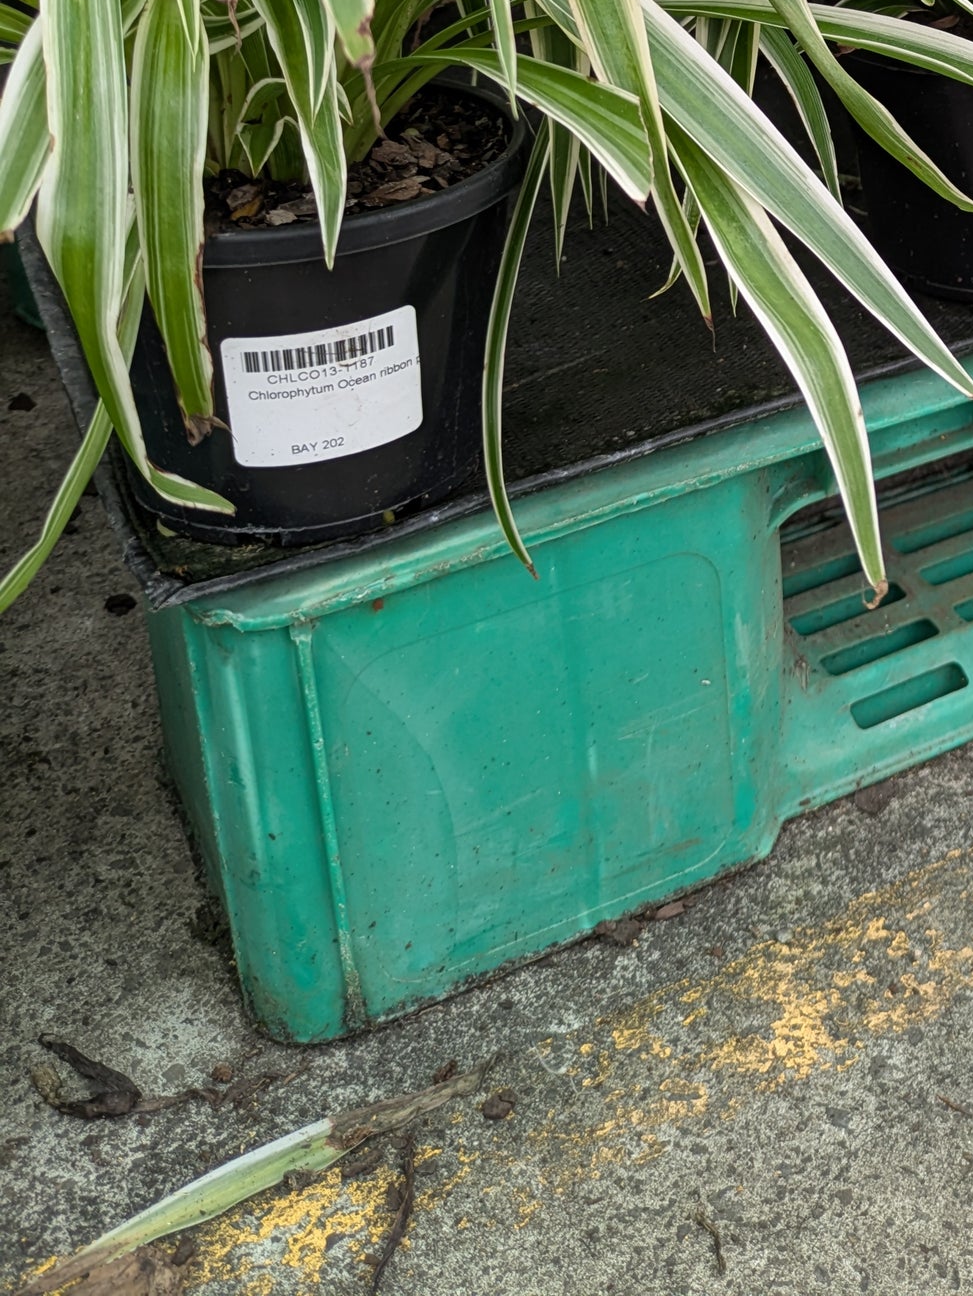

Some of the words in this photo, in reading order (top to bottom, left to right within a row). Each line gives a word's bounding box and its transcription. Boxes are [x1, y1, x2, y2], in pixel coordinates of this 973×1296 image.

[248, 383, 335, 401] Chlorophytum
[337, 372, 377, 389] Ocean
[380, 358, 413, 377] ribbon
[291, 441, 318, 455] BAY
[321, 436, 345, 450] 202
